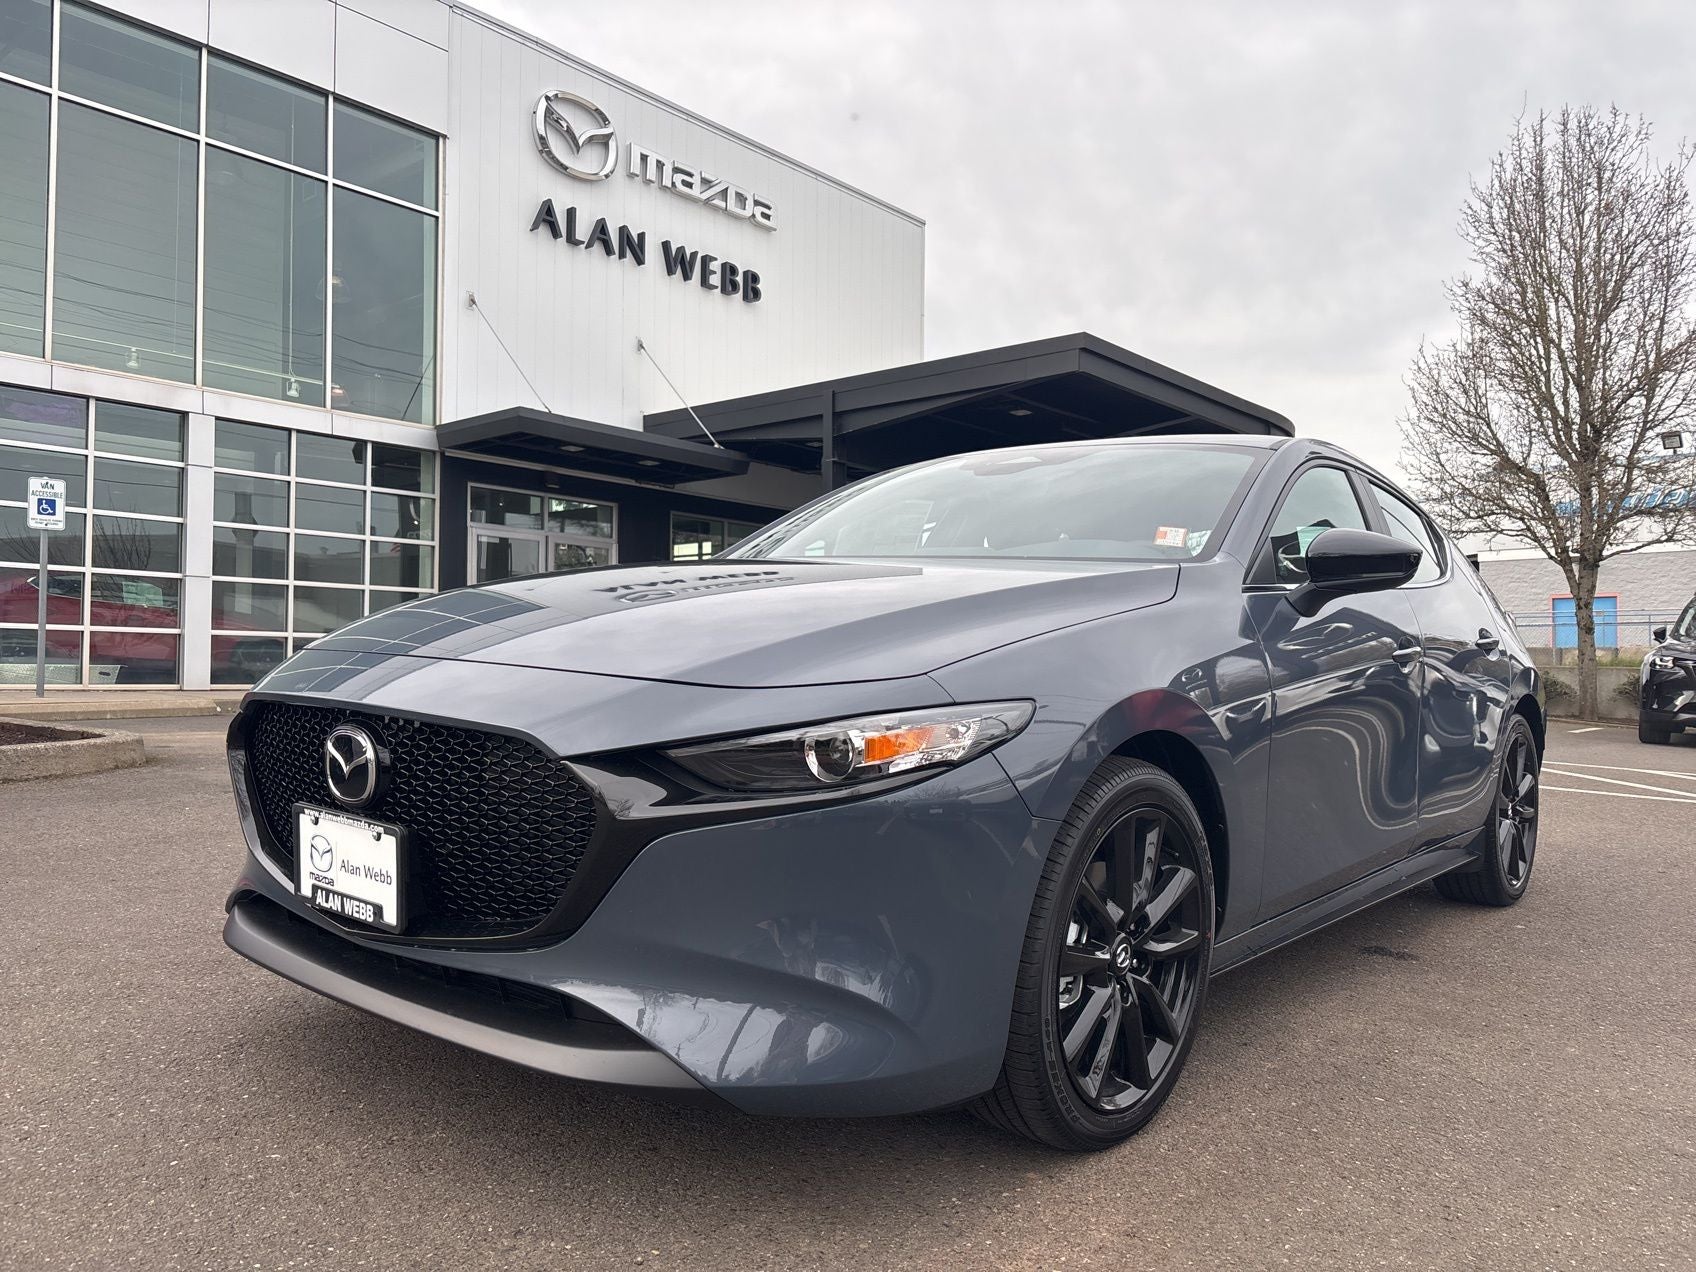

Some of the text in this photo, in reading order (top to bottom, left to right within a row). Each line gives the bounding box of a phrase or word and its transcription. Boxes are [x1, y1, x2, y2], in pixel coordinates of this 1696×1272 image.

[529, 198, 762, 303] ALAN WEBB
[31, 490, 63, 498] ACCESSIBLE
[40, 481, 55, 490] VAN
[304, 809, 384, 834] www.alanwebbmazda.com
[309, 871, 335, 887] mazda
[340, 859, 393, 886] Alan Webb
[315, 889, 374, 922] ALAN WEBB
